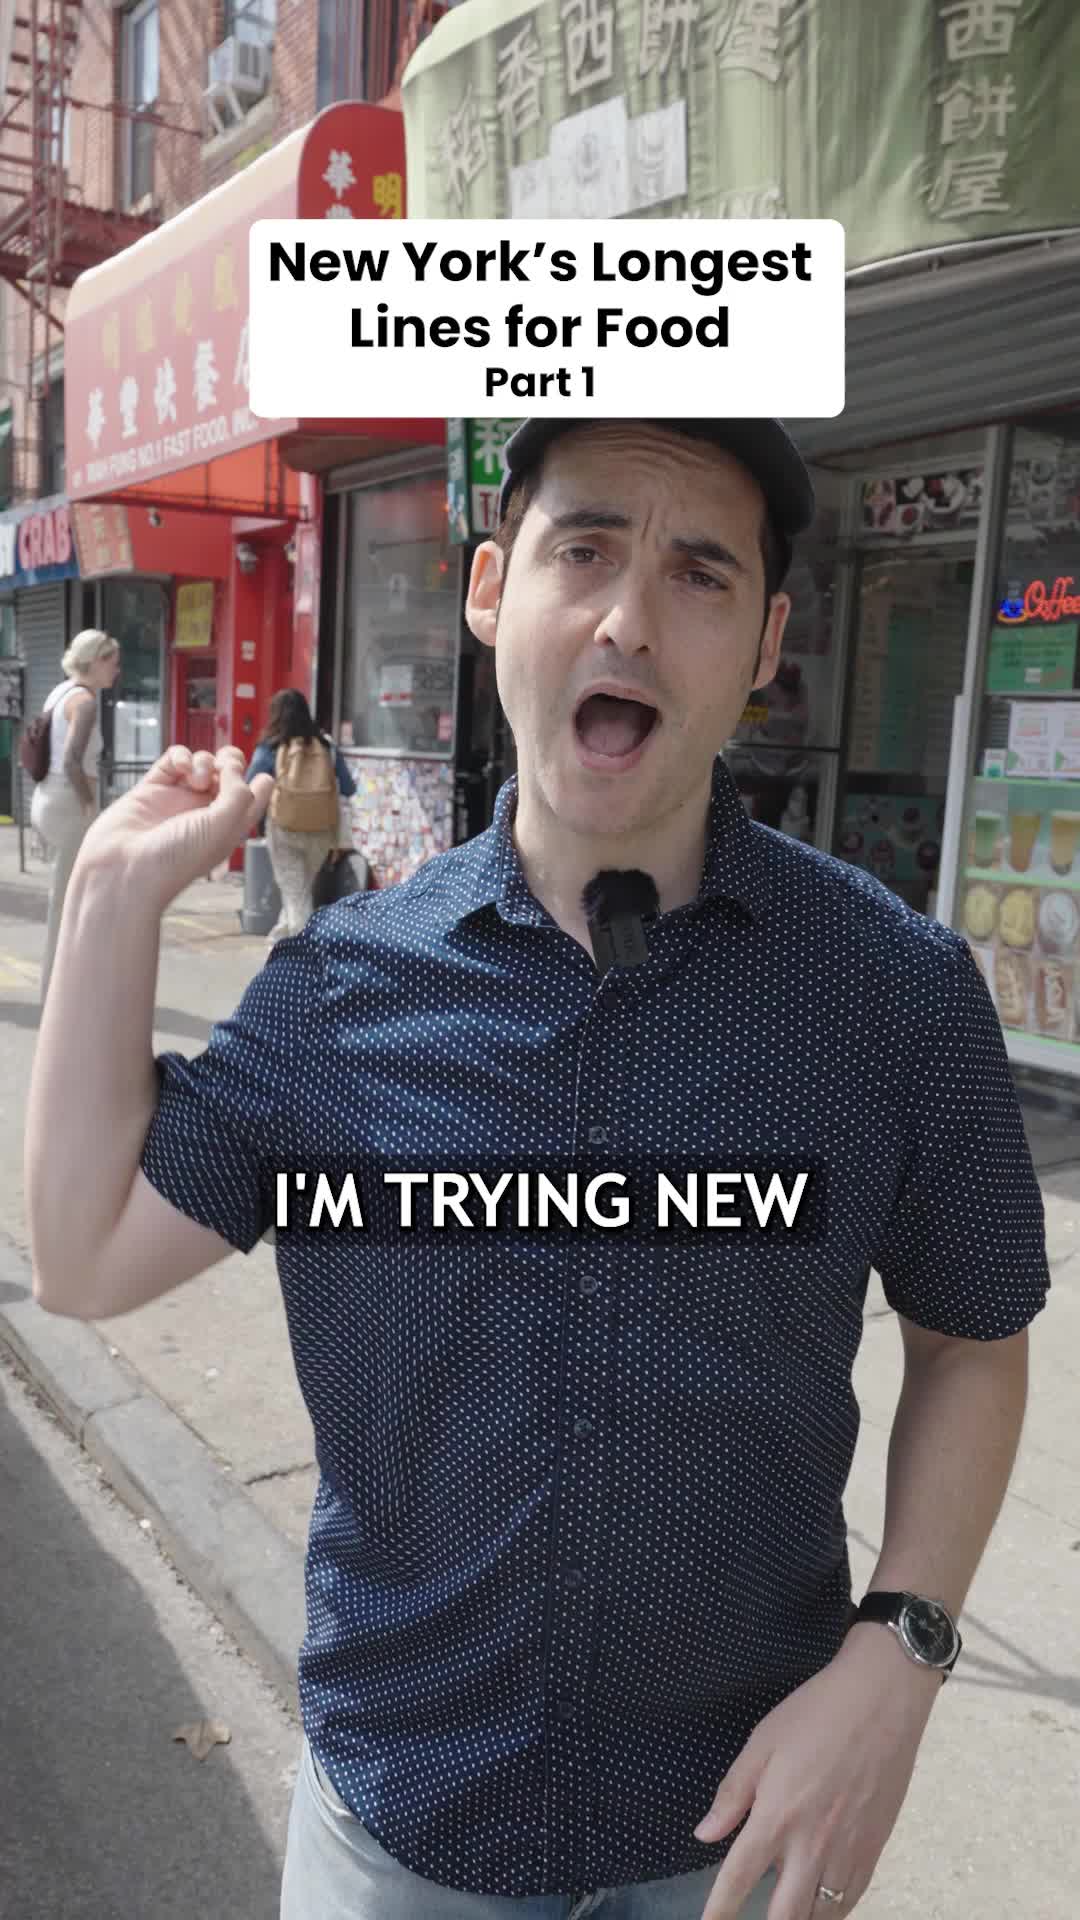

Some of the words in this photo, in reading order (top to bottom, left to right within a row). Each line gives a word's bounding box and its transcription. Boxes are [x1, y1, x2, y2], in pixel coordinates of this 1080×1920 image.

[163, 427, 191, 457] FAST
[19, 507, 71, 572] CRAB
[1023, 576, 1080, 622] Coffee
